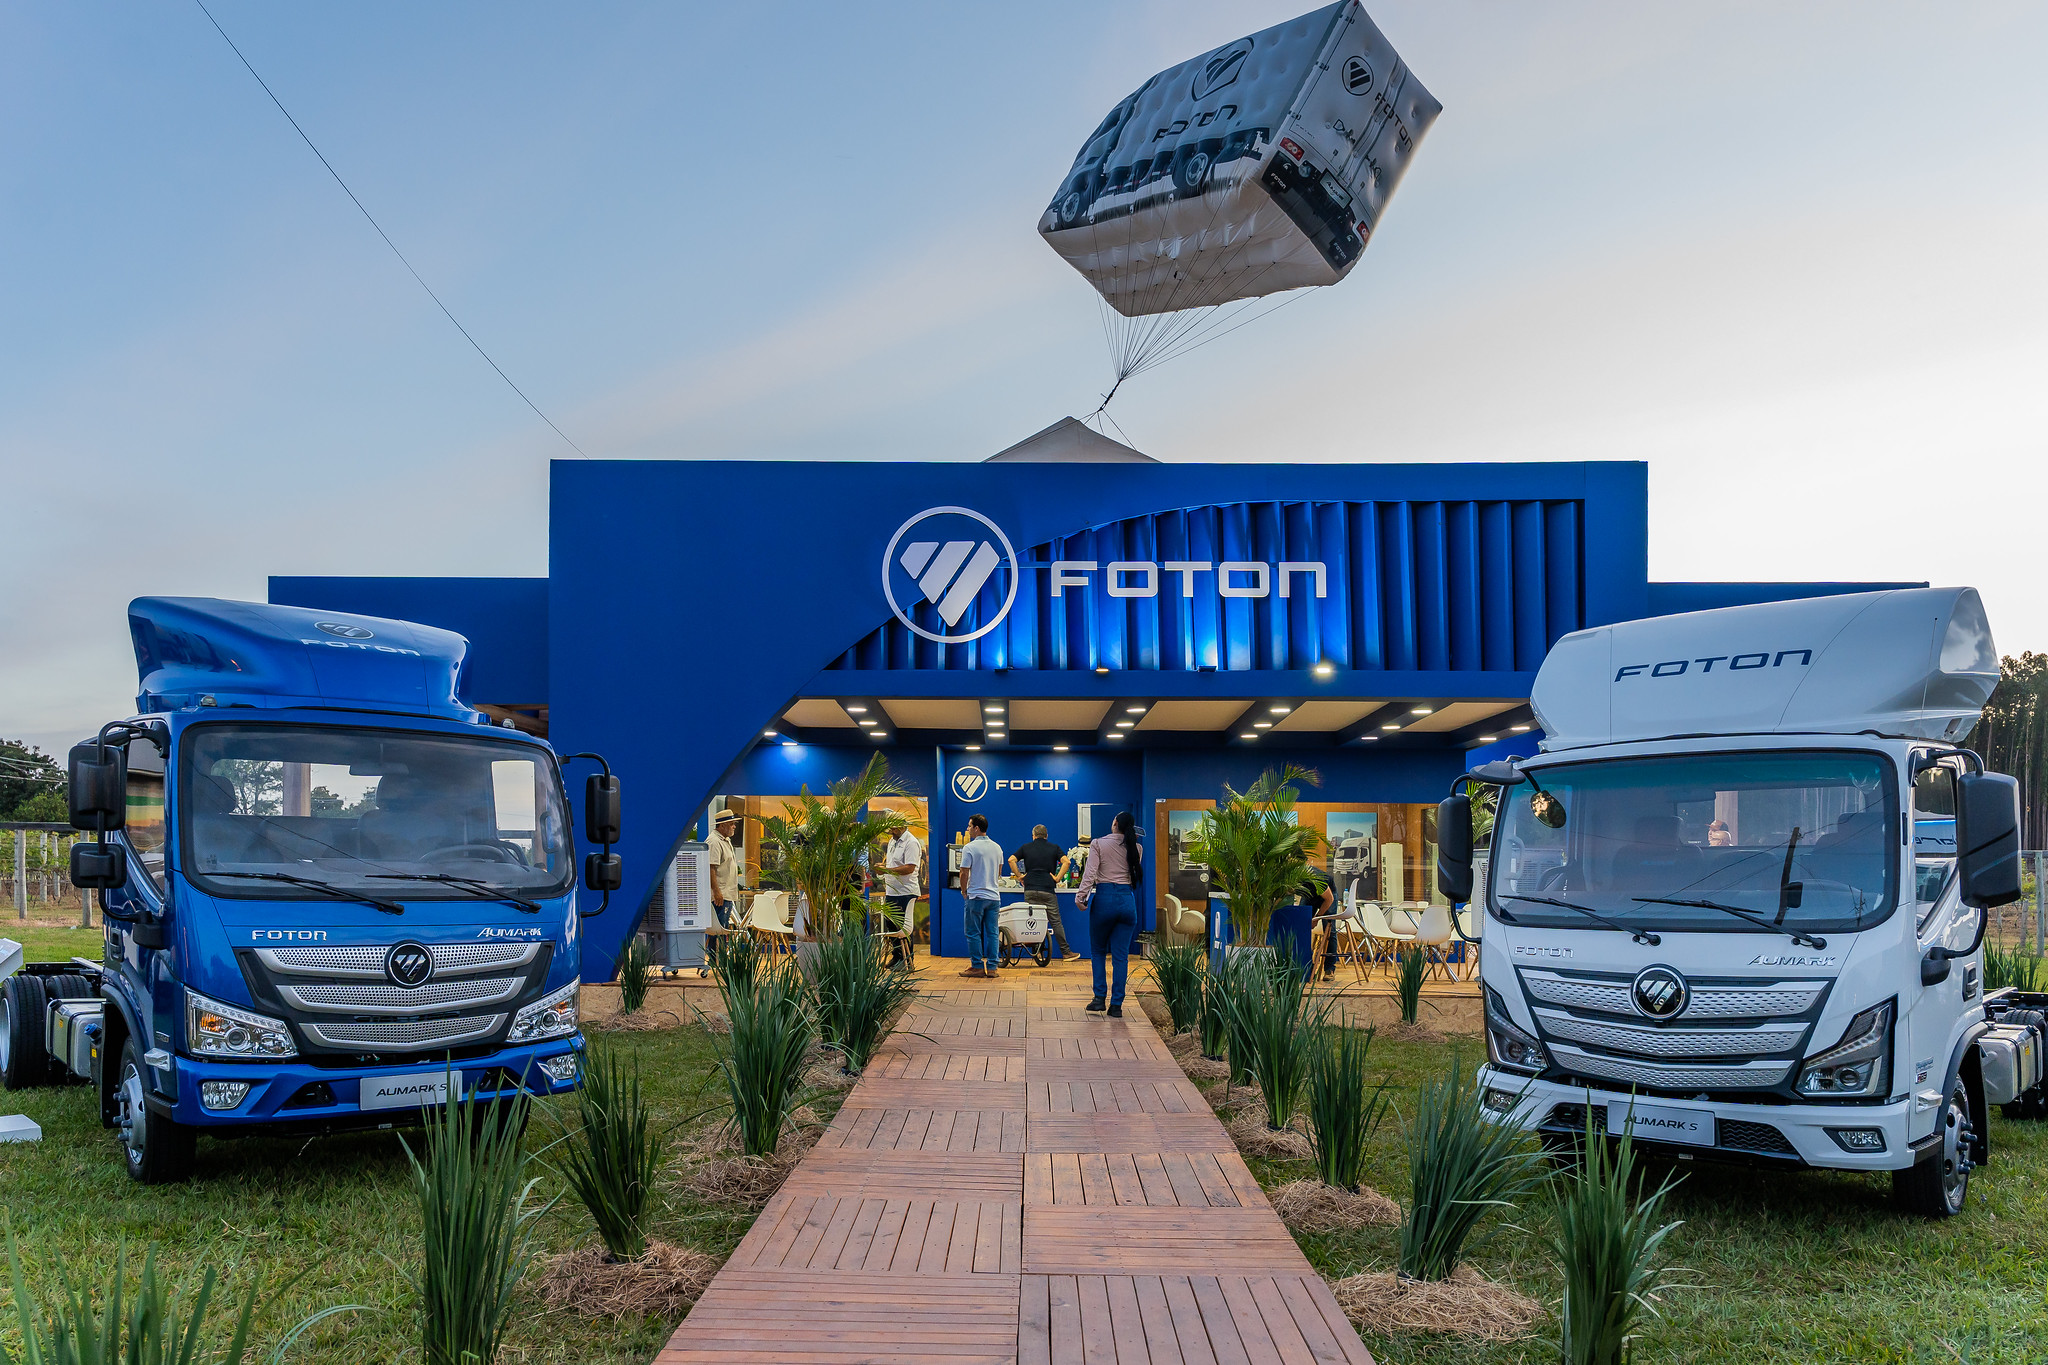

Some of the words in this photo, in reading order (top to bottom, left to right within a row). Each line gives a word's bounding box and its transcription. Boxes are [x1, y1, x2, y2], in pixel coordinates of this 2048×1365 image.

[1051, 561, 1327, 598] FOTON
[300, 639, 421, 657] FOTON
[1614, 649, 1813, 682] FOTON
[995, 779, 1069, 791] FOTON
[251, 929, 327, 941] FOTON
[476, 927, 542, 938] AUMARK
[1514, 945, 1575, 958] FOTON
[1747, 954, 1836, 967] AUMARK
[376, 1084, 436, 1097] AUMARK
[438, 1083, 448, 1092] S
[1688, 1122, 1699, 1131] S
